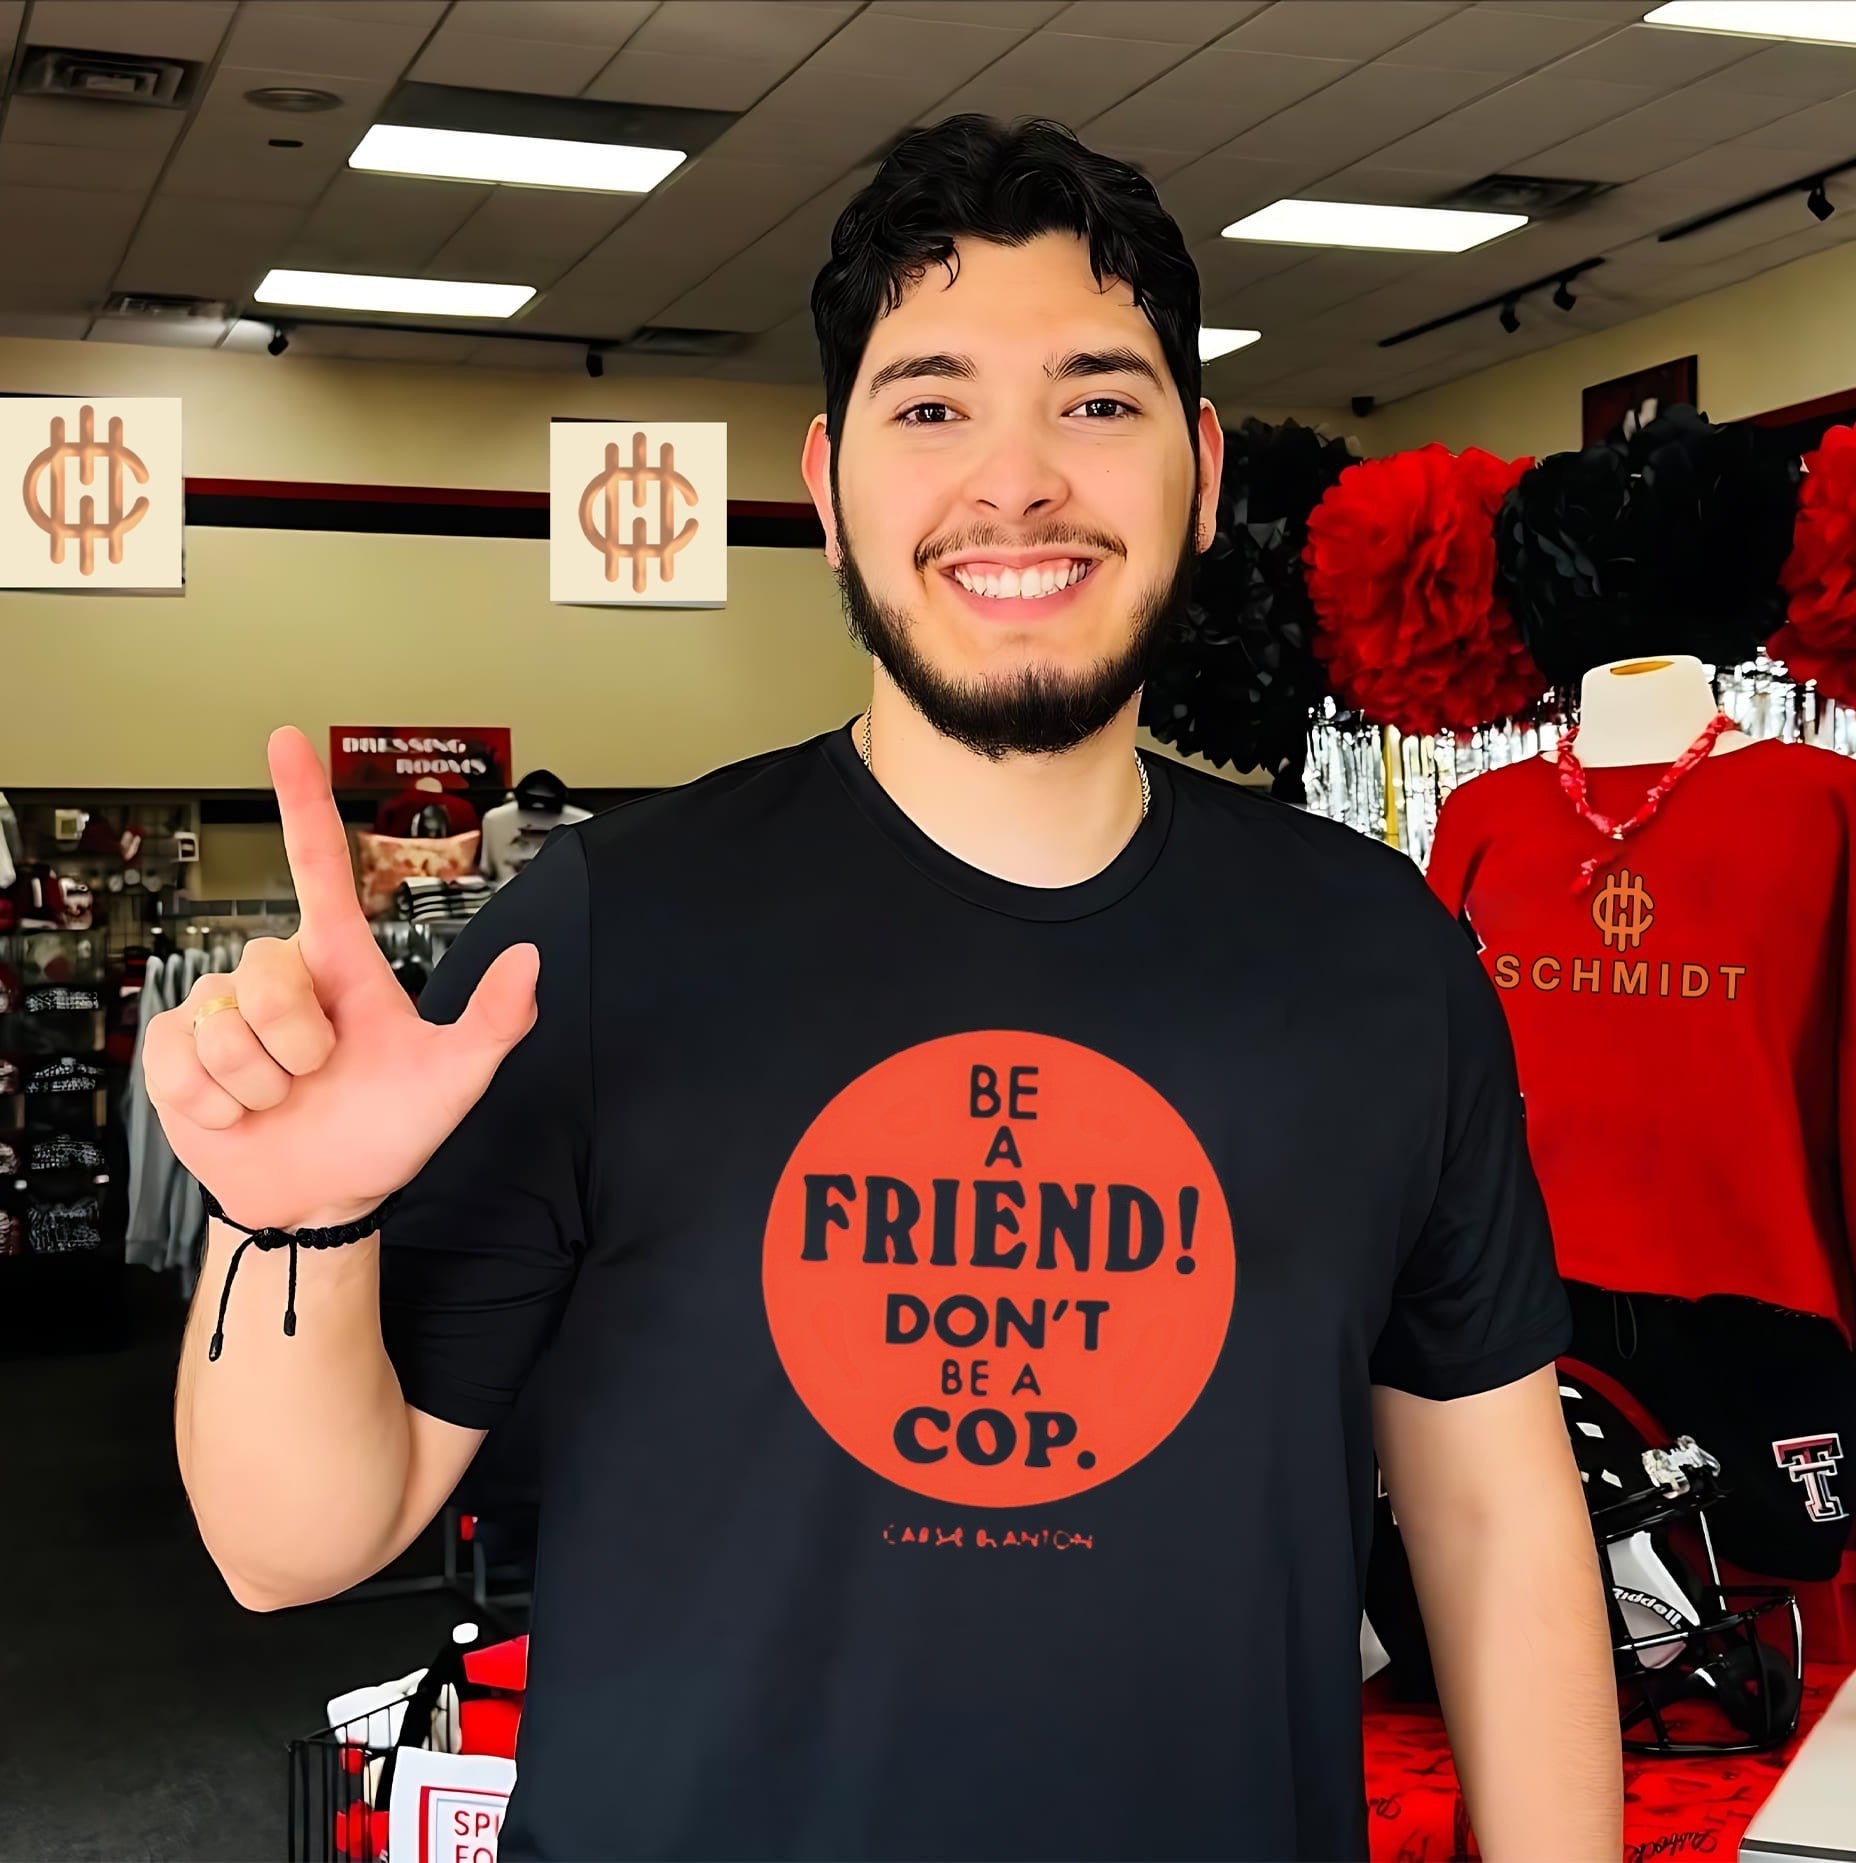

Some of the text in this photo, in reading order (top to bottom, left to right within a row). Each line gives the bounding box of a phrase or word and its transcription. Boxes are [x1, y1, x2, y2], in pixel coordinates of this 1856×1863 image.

[396, 758, 487, 775] ROOMS
[1494, 954, 1746, 999] SCHMIDT
[969, 1064, 1039, 1120] BE
[984, 1125, 1023, 1169] A
[800, 1173, 1200, 1275] FRIEND!
[885, 1293, 1110, 1351] DON'T
[941, 1358, 1041, 1397] BE A
[892, 1406, 1096, 1470] COP.
